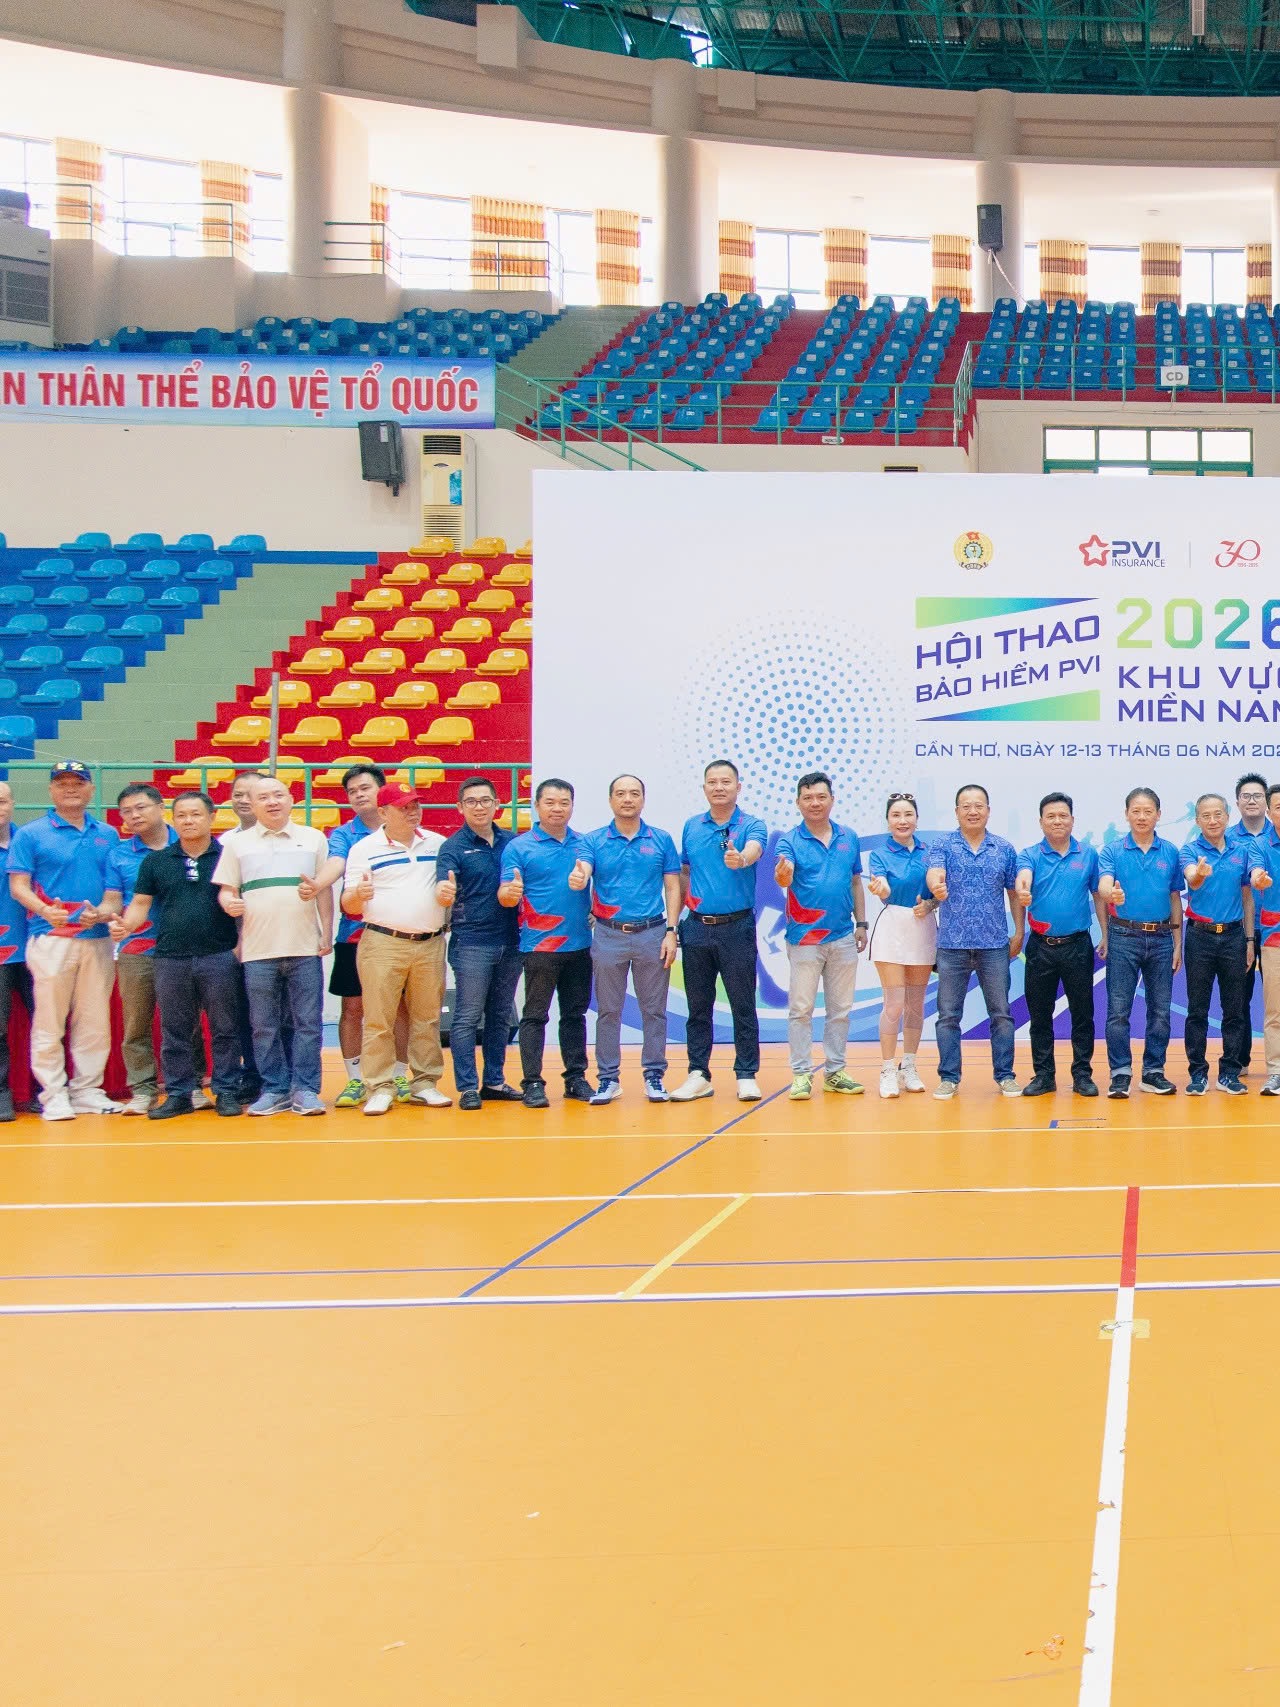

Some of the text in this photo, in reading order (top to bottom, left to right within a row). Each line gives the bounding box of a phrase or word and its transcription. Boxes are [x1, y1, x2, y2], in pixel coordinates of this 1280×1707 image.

[38, 365, 125, 407] THÂN
[137, 360, 201, 408] THỂ
[212, 361, 276, 409] BẢO
[288, 369, 329, 417] VỆ
[341, 362, 383, 411] TỔ
[392, 367, 478, 415] QUỐC
[1166, 372, 1184, 381] CD
[1112, 541, 1161, 558] PVI
[1112, 558, 1166, 568] INSURANCE
[916, 615, 1100, 669] HỘI THAO
[916, 655, 1100, 703] BẢO HIỂM PVI
[1118, 665, 1200, 689] KHU
[1118, 692, 1205, 722] MIỀN
[915, 740, 953, 757] CẦN
[959, 741, 1001, 759] THƠ,
[1007, 740, 1055, 757] NGÀY
[1061, 744, 1102, 757] 12-13
[1107, 741, 1170, 757] THÁNG
[1176, 744, 1200, 757] 06
[1206, 741, 1246, 757] NĂM
